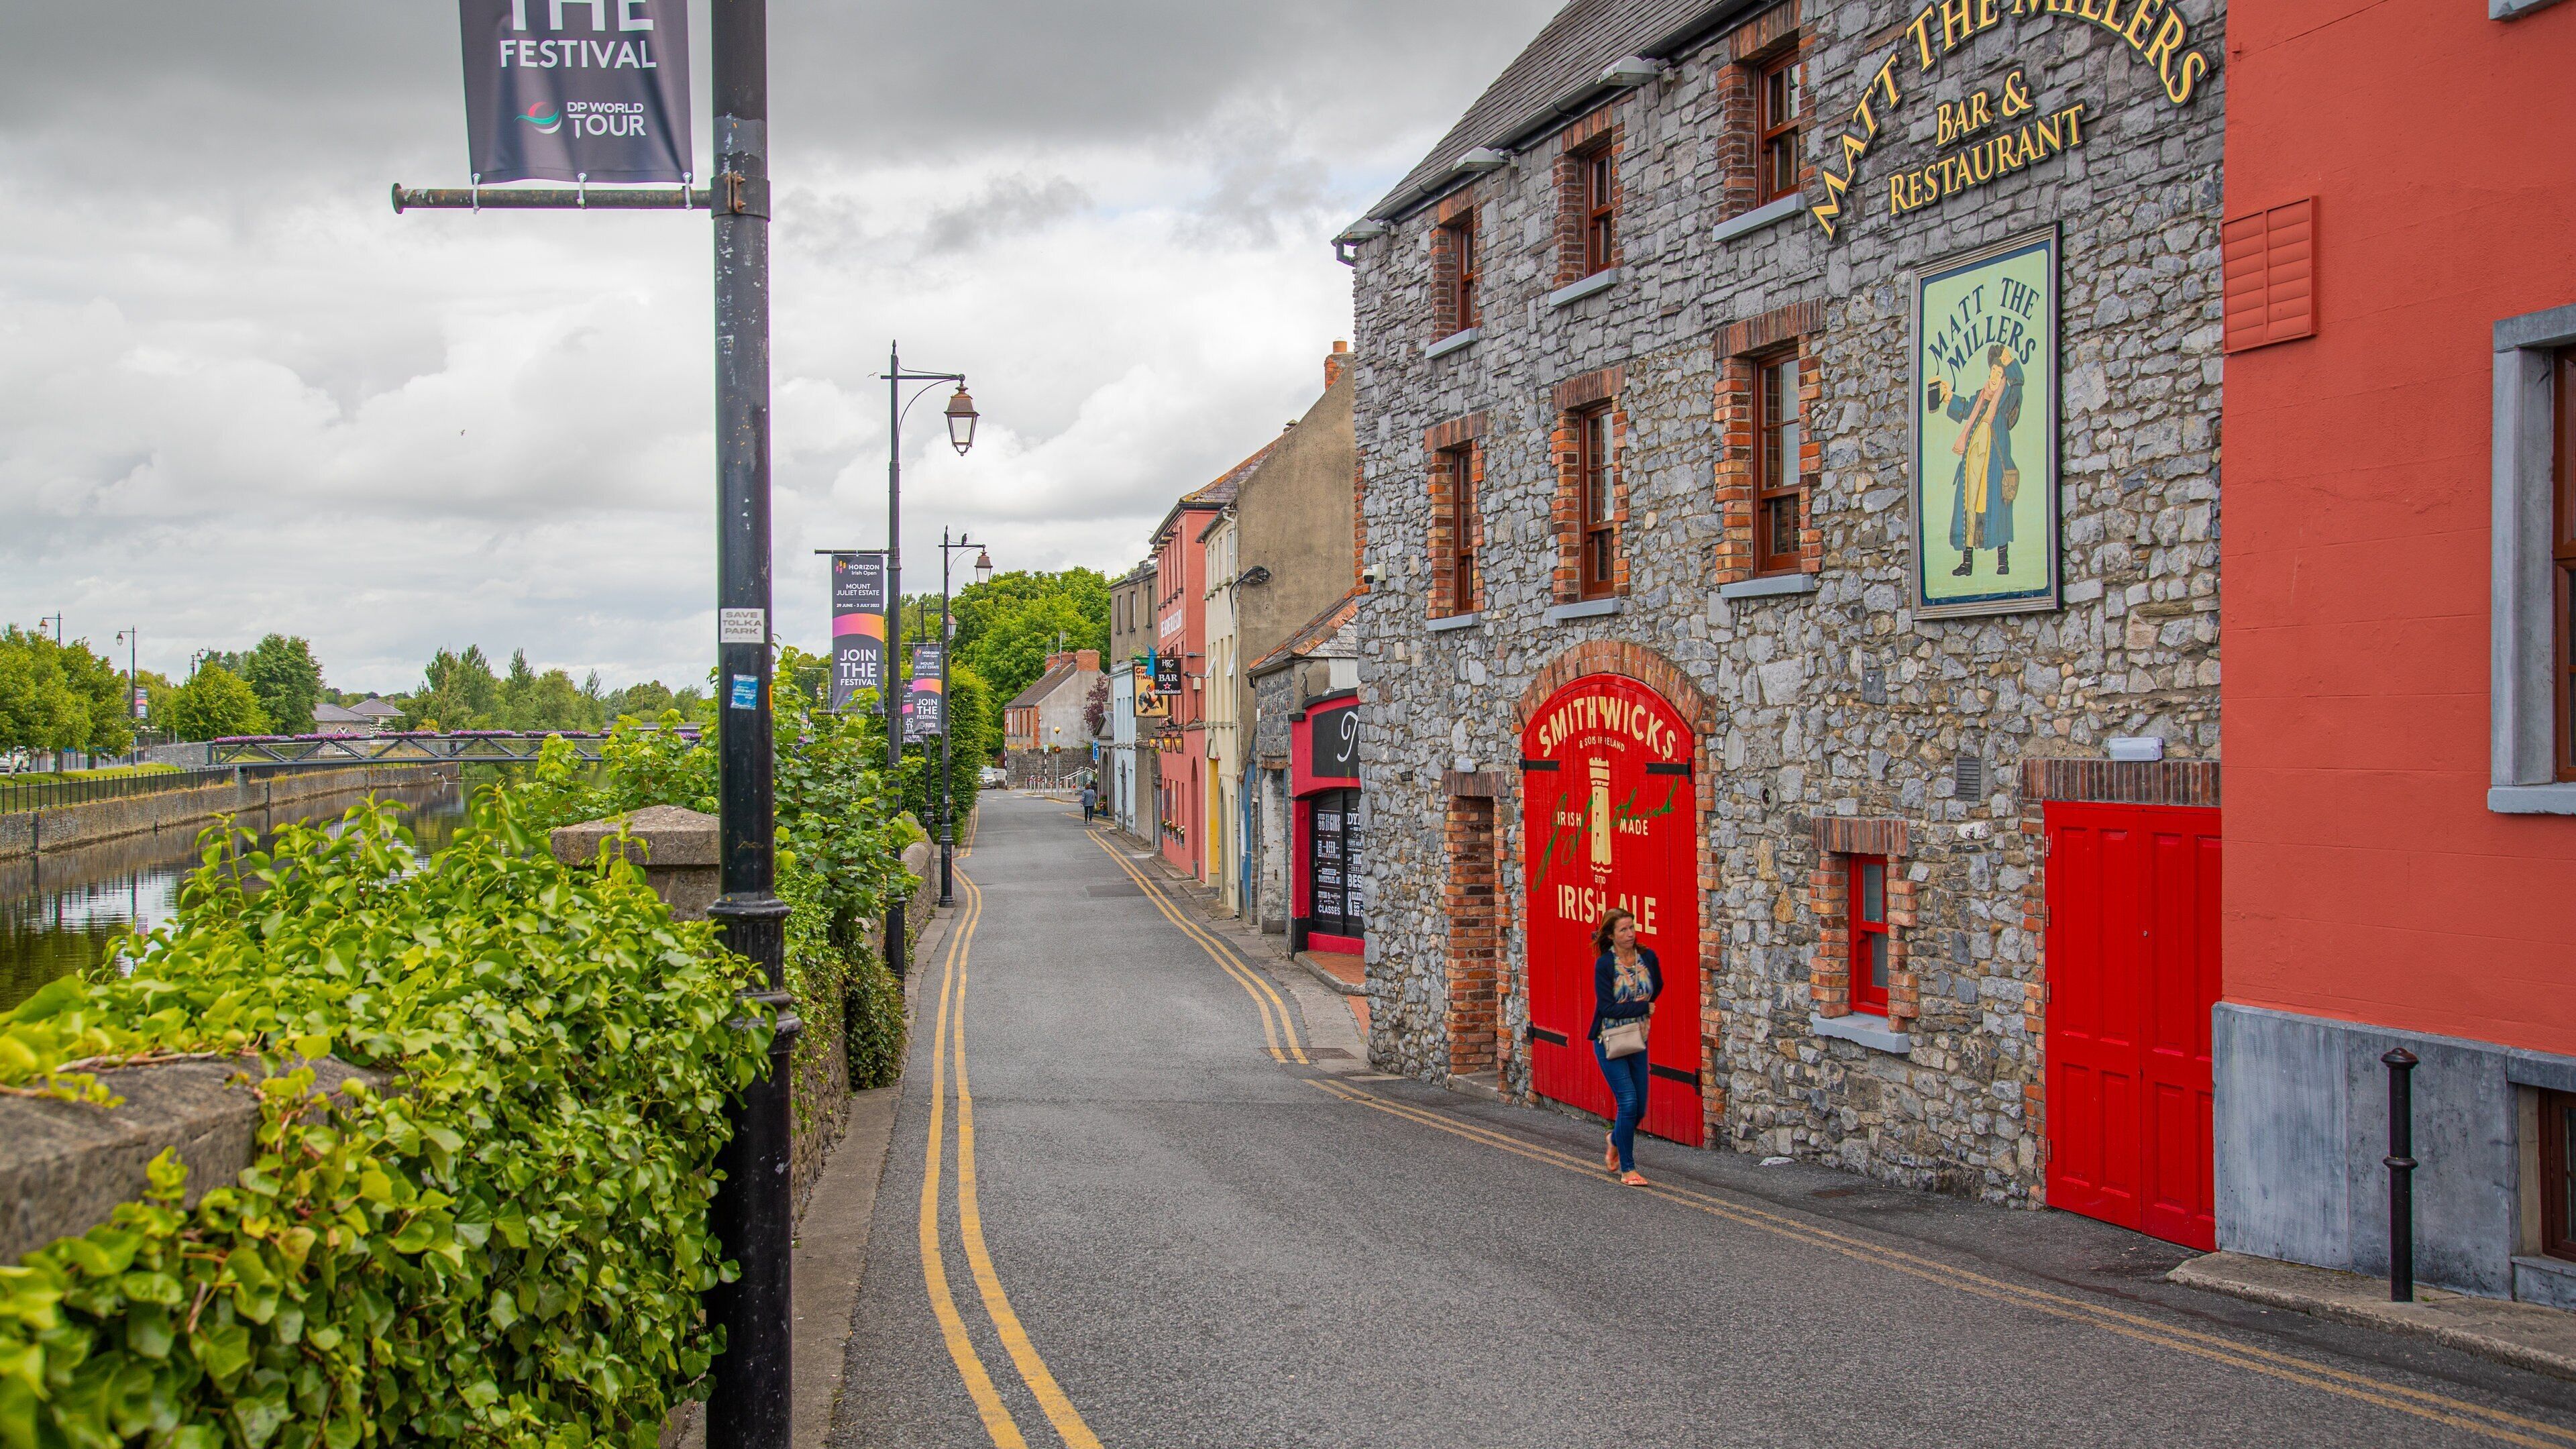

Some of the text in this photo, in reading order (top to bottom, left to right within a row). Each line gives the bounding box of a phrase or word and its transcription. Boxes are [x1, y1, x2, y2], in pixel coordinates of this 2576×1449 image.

[500, 39, 657, 68] FESTIVAL
[567, 101, 645, 113] DP WORLD
[1935, 70, 2033, 148] BAR &
[568, 114, 647, 139] TOUR
[1812, 53, 1898, 241] MATT
[1906, 0, 2000, 71] THE
[1888, 103, 2084, 216] RESTAURANT
[1928, 277, 2040, 376] MATT THE
[1947, 315, 2037, 392] MILLERS
[839, 649, 877, 661] JOIN
[840, 662, 877, 678] THE
[1158, 674, 1178, 682] BAR
[916, 706, 938, 715] THE
[1579, 740, 1584, 749] &
[1330, 814, 1340, 832] GINS
[1557, 811, 1582, 827] IRISH
[1619, 818, 1649, 836] MADE
[1326, 841, 1336, 854] BEER
[1347, 873, 1363, 888] BES
[1318, 904, 1340, 916] CLASSES
[1558, 884, 1607, 924] IRISH
